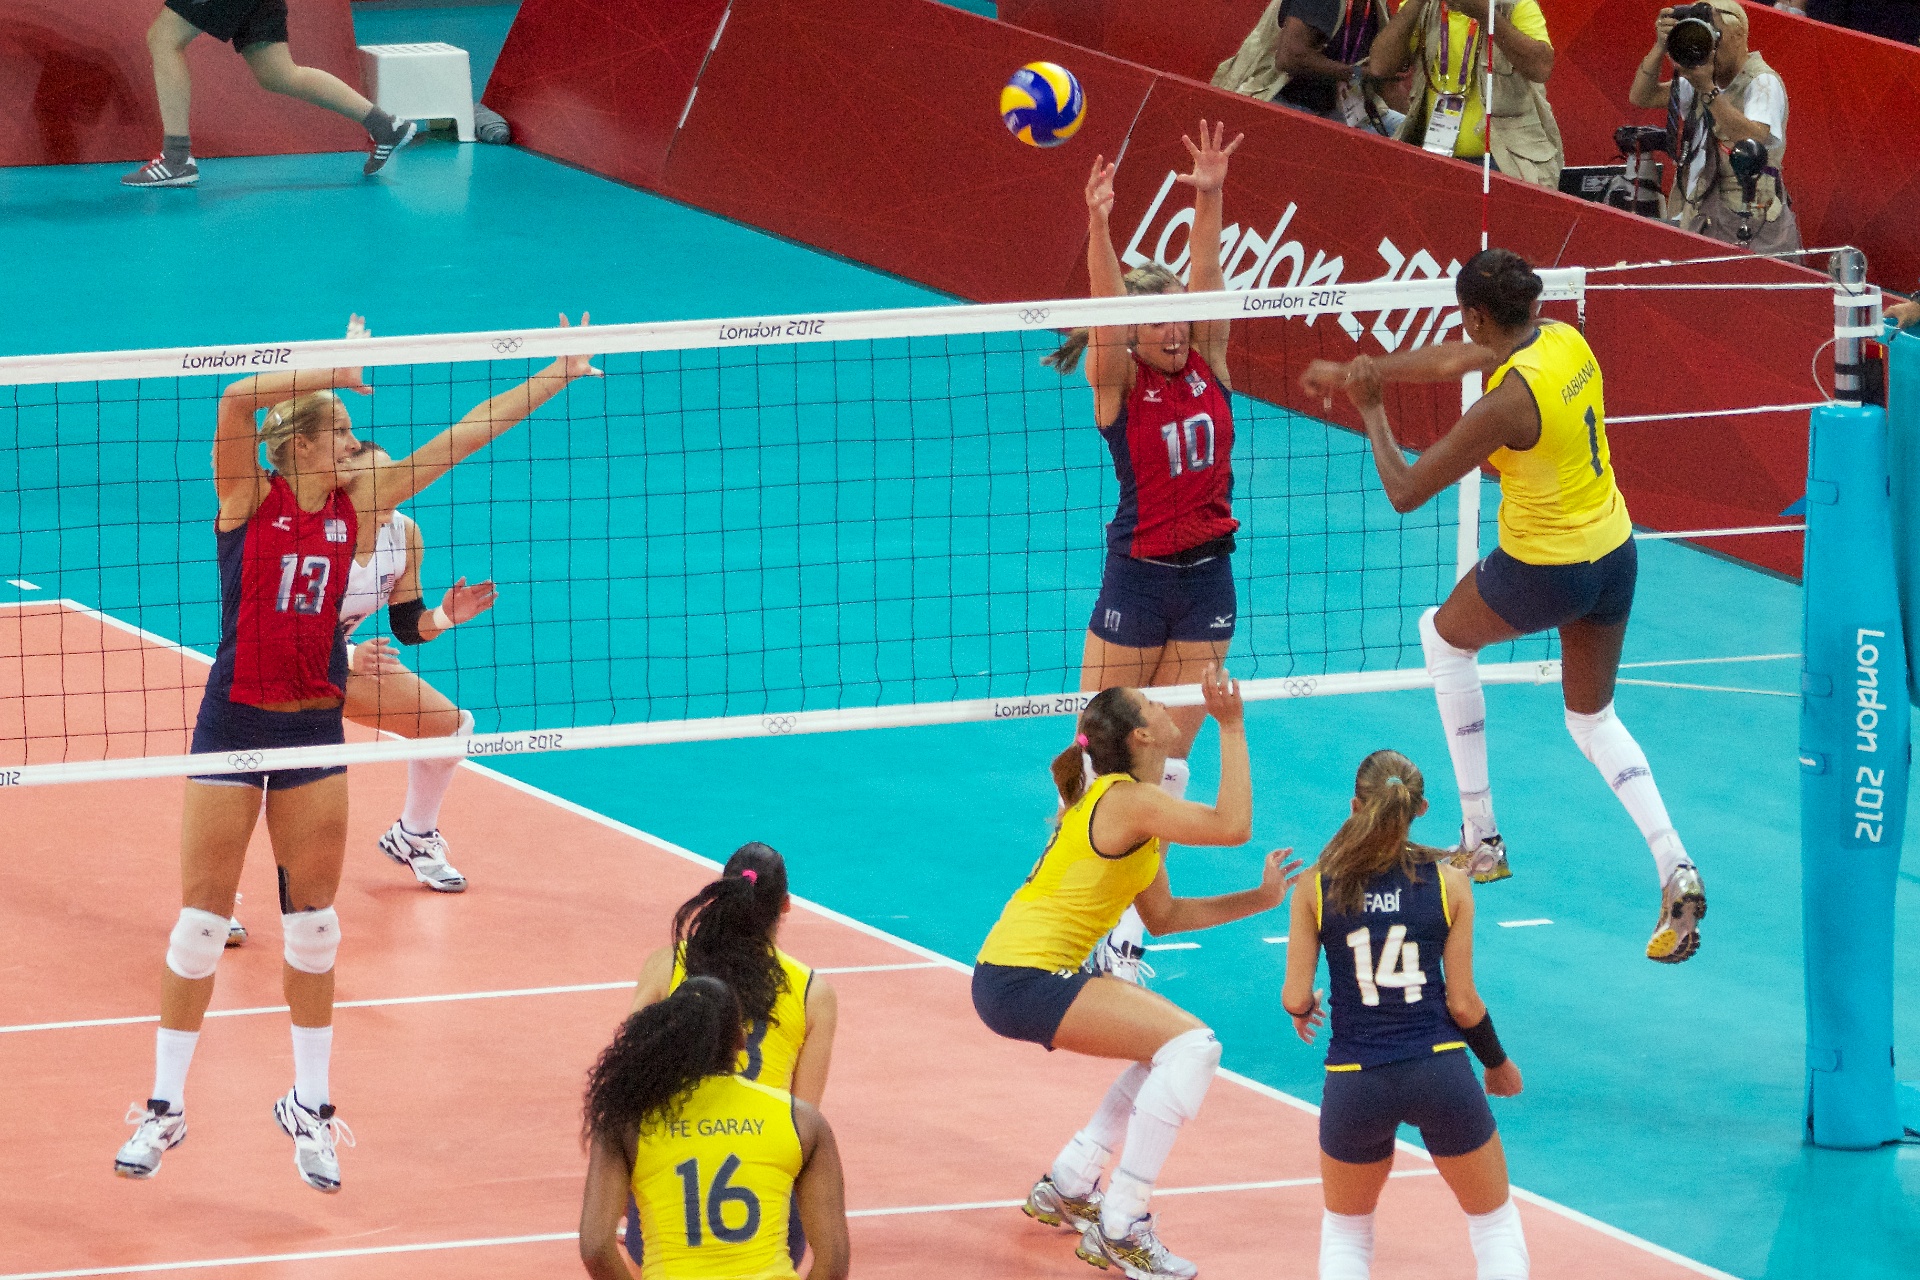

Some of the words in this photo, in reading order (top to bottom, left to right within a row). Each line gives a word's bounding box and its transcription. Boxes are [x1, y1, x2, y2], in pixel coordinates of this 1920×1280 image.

[1243, 293, 1303, 311] London
[1308, 291, 1347, 307] 2012
[719, 321, 781, 340] London
[786, 319, 825, 336] 2012
[182, 350, 246, 369] London
[251, 348, 292, 365] 2012
[1561, 360, 1596, 405] FABIANA
[1161, 412, 1215, 478] 10
[1584, 405, 1603, 477] 1
[275, 553, 331, 615] 13
[1104, 608, 1121, 632] 10
[994, 699, 1050, 717] London
[1055, 697, 1088, 713] 2012
[1856, 628, 1887, 752] London
[467, 737, 523, 754] London
[528, 734, 563, 749] 2012
[1854, 765, 1885, 843] 2012
[1363, 889, 1402, 913] FABÍ
[1346, 924, 1427, 1006] 14
[670, 1119, 691, 1138] FE
[697, 1119, 764, 1137] GARAY
[675, 1152, 761, 1247] 16
